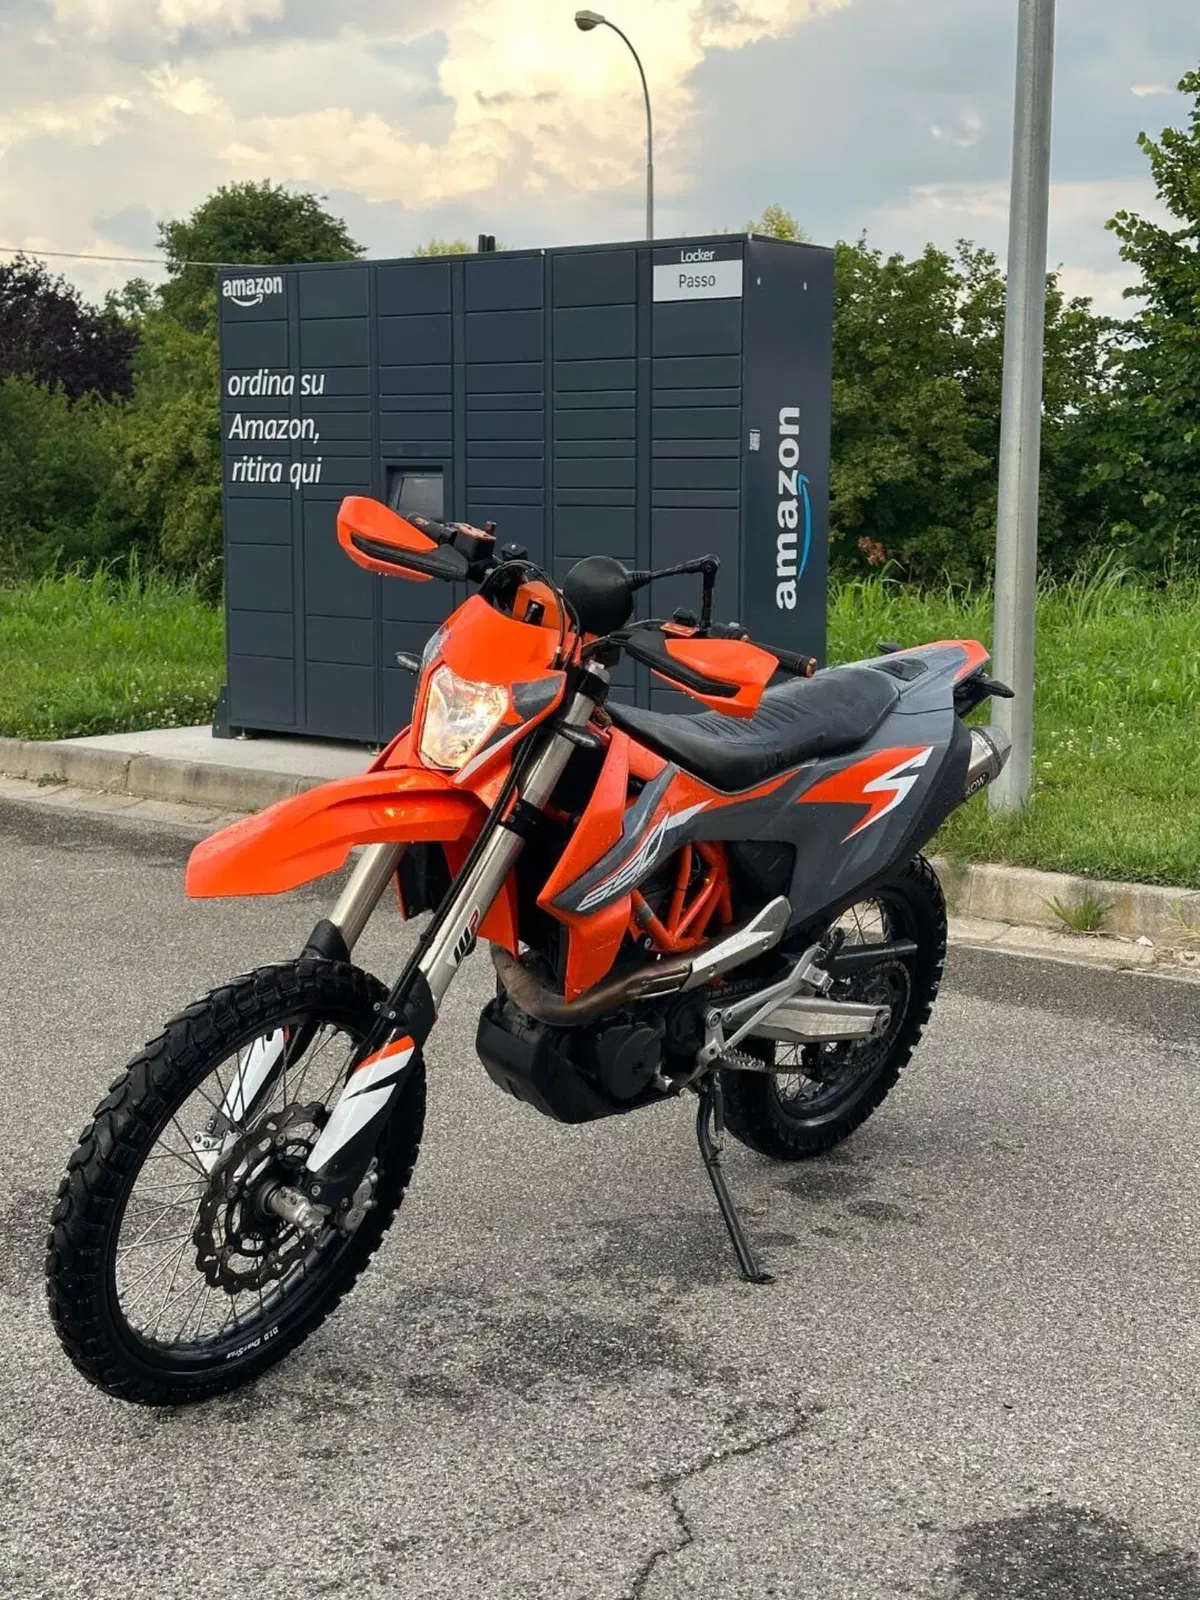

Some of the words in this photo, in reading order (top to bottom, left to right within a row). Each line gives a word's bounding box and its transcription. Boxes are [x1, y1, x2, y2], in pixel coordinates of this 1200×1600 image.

[680, 249, 715, 263] Locker
[222, 276, 283, 299] amazon
[678, 274, 716, 288] Passo
[228, 369, 295, 396] ordina
[301, 373, 325, 395] su
[228, 413, 320, 444] Amazon,
[232, 456, 282, 482] ritira
[290, 457, 322, 490] qui
[776, 406, 801, 610] amazon
